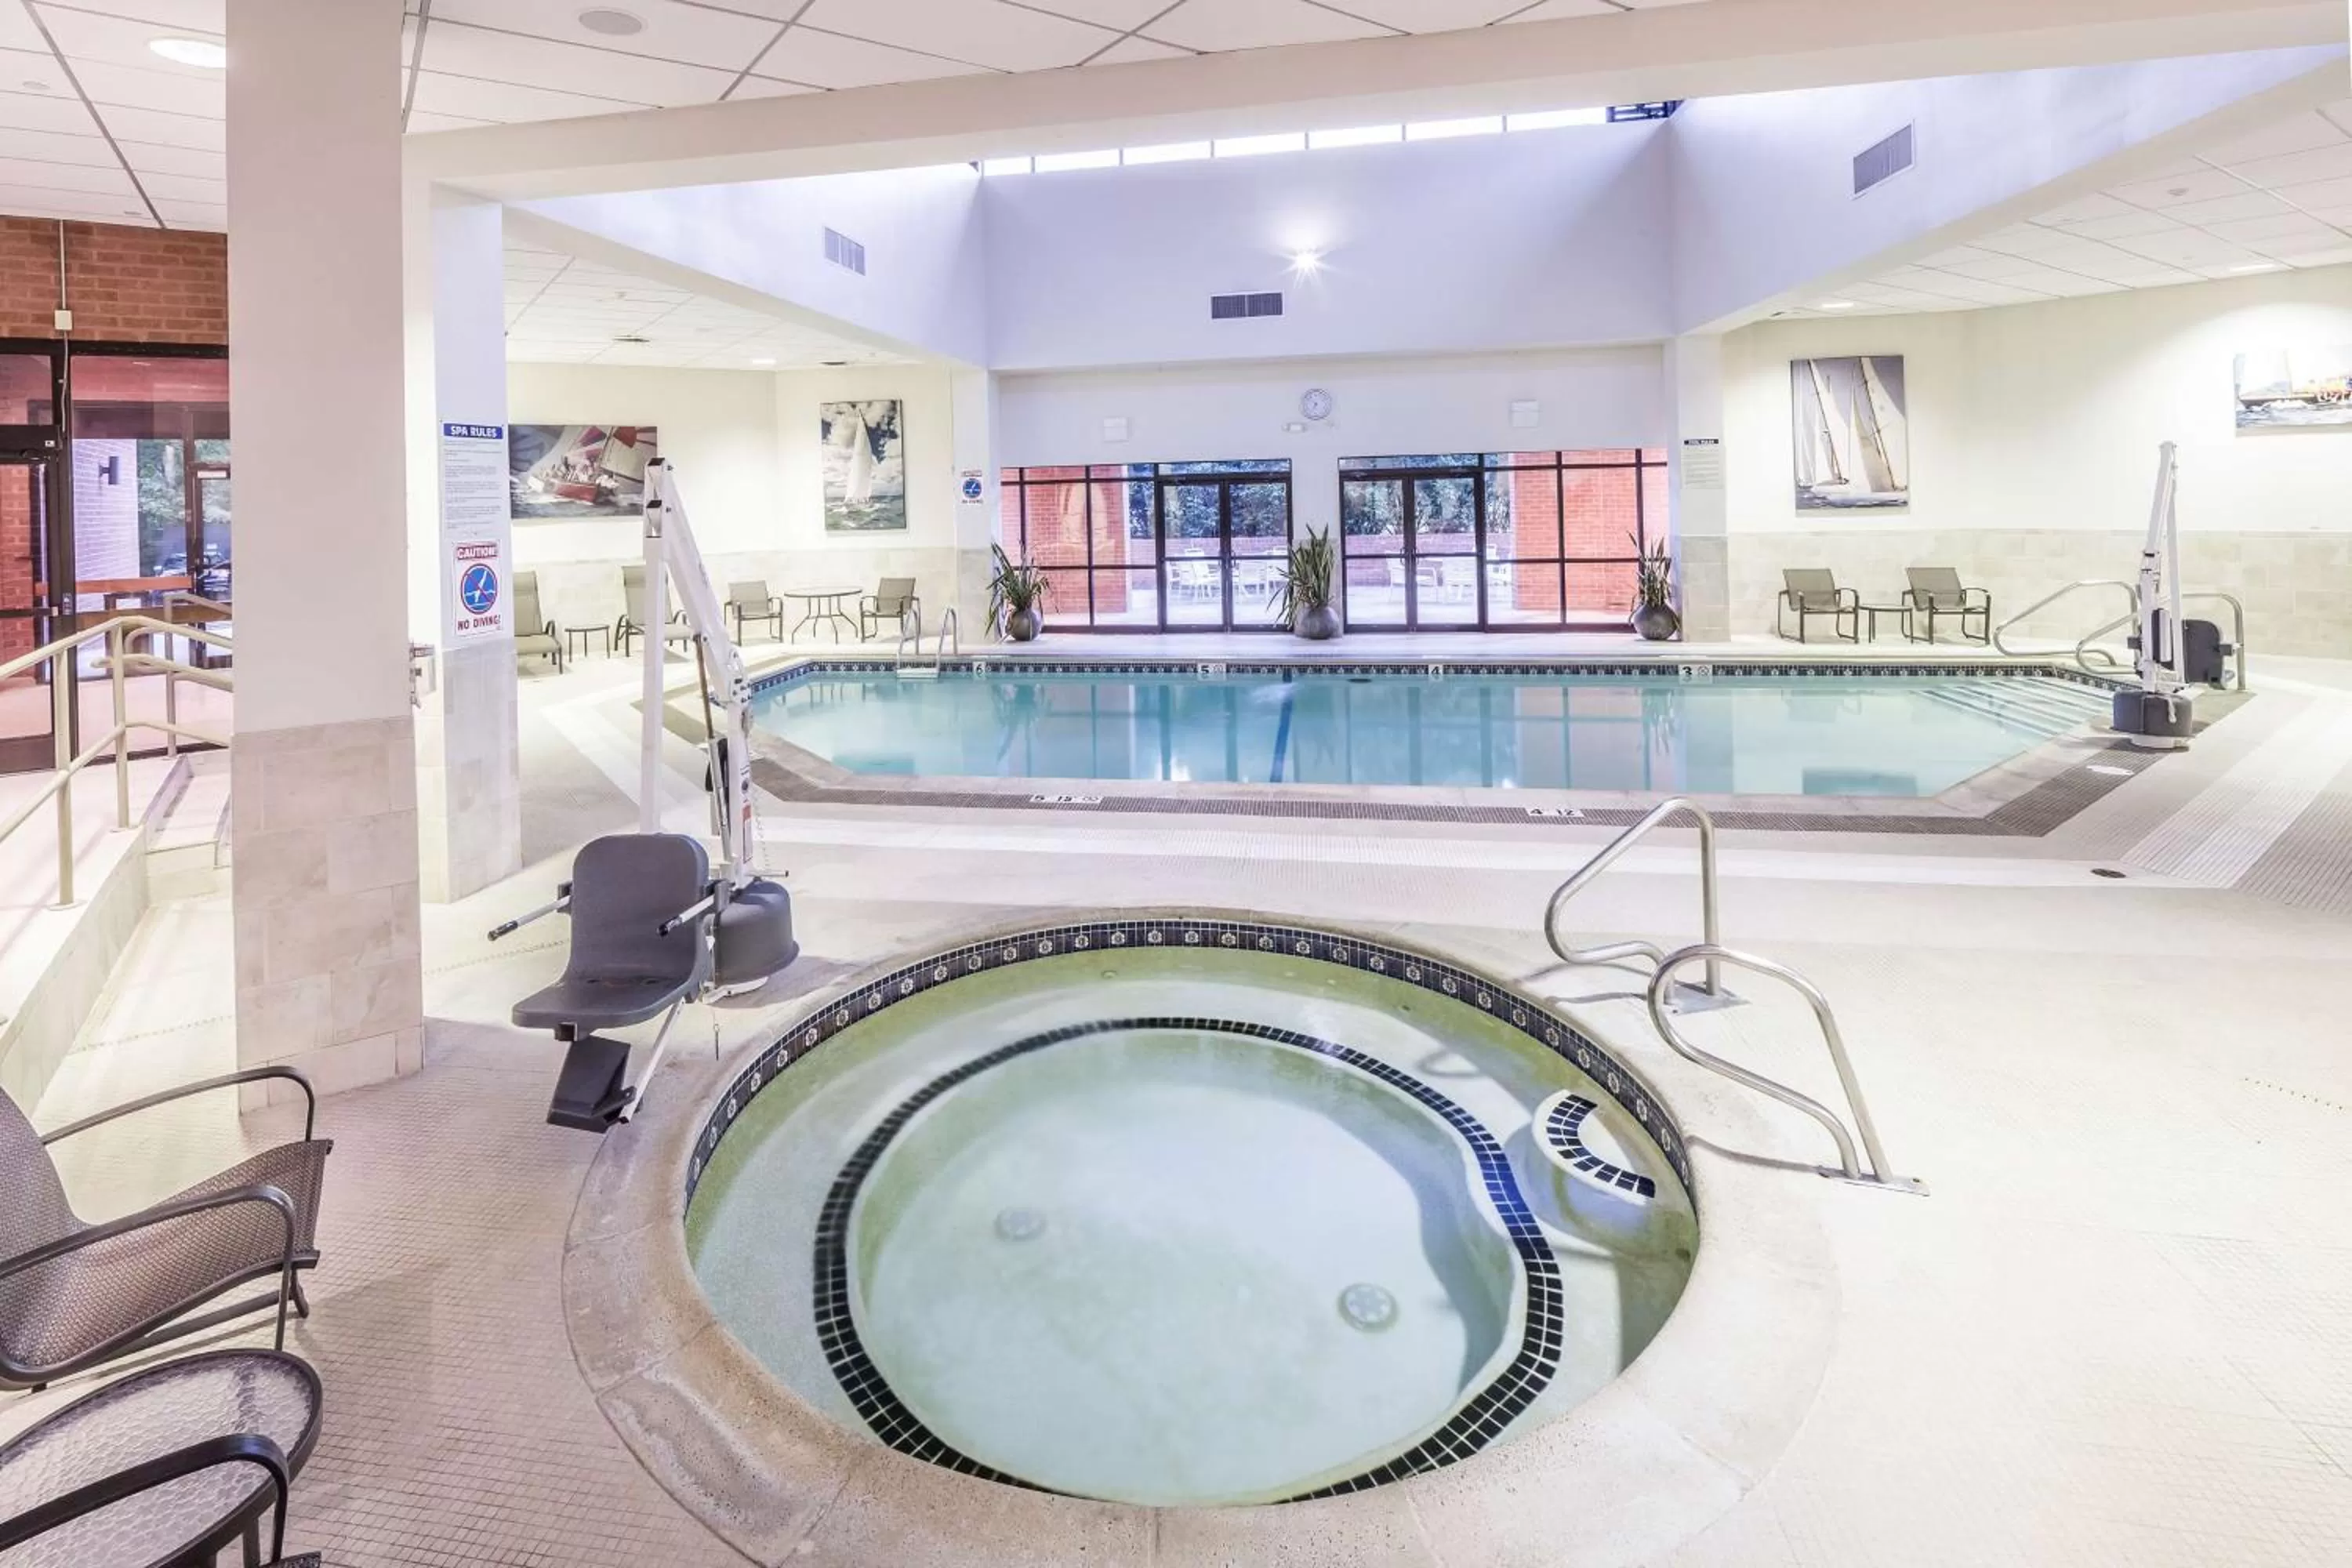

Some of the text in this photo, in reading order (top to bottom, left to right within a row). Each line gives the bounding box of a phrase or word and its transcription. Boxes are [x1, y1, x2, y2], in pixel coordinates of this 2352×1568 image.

[451, 425, 497, 437] SPA RULES
[457, 619, 470, 631] NO
[975, 663, 984, 677] 6
